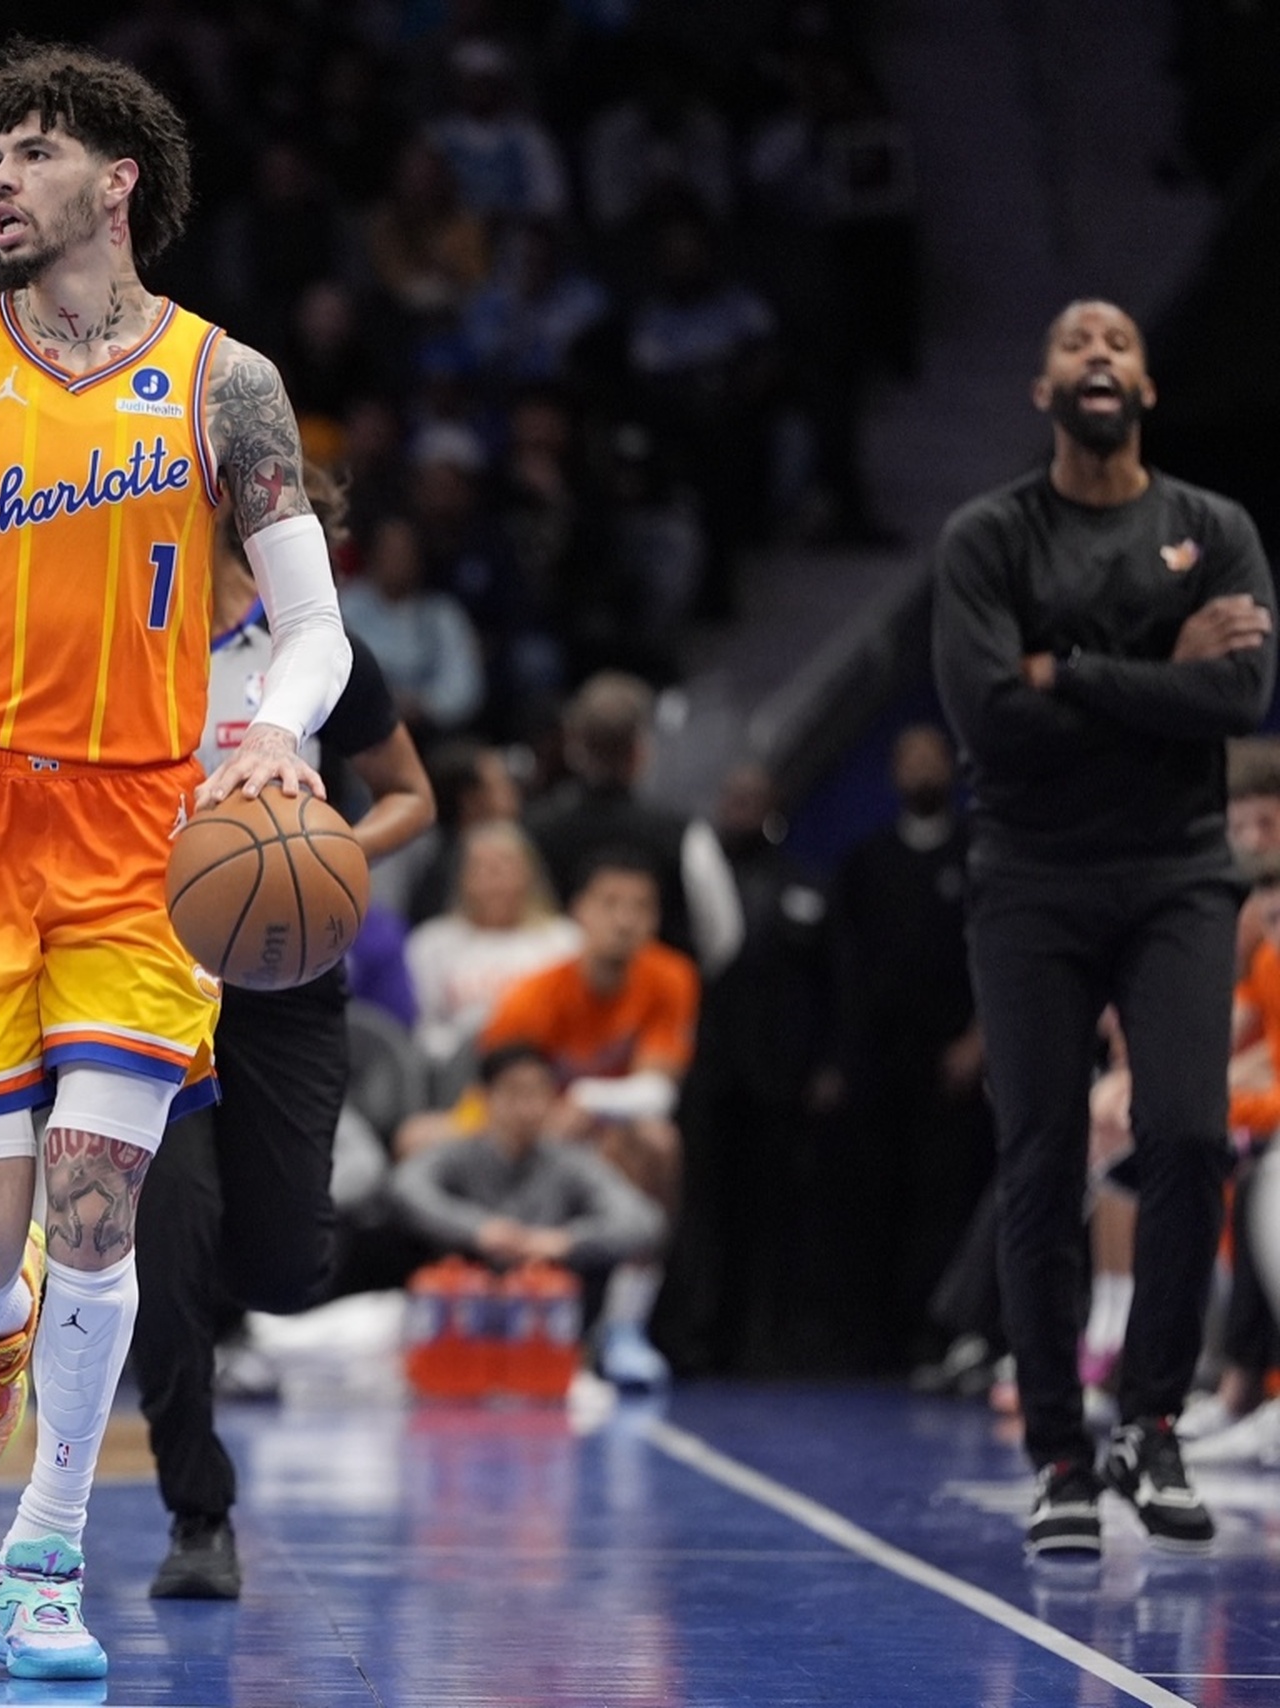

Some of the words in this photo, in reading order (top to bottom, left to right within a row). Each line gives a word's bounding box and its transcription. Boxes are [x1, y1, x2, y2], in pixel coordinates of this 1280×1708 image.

[119, 400, 145, 411] Judi
[146, 403, 182, 416] Health
[147, 541, 178, 630] 1
